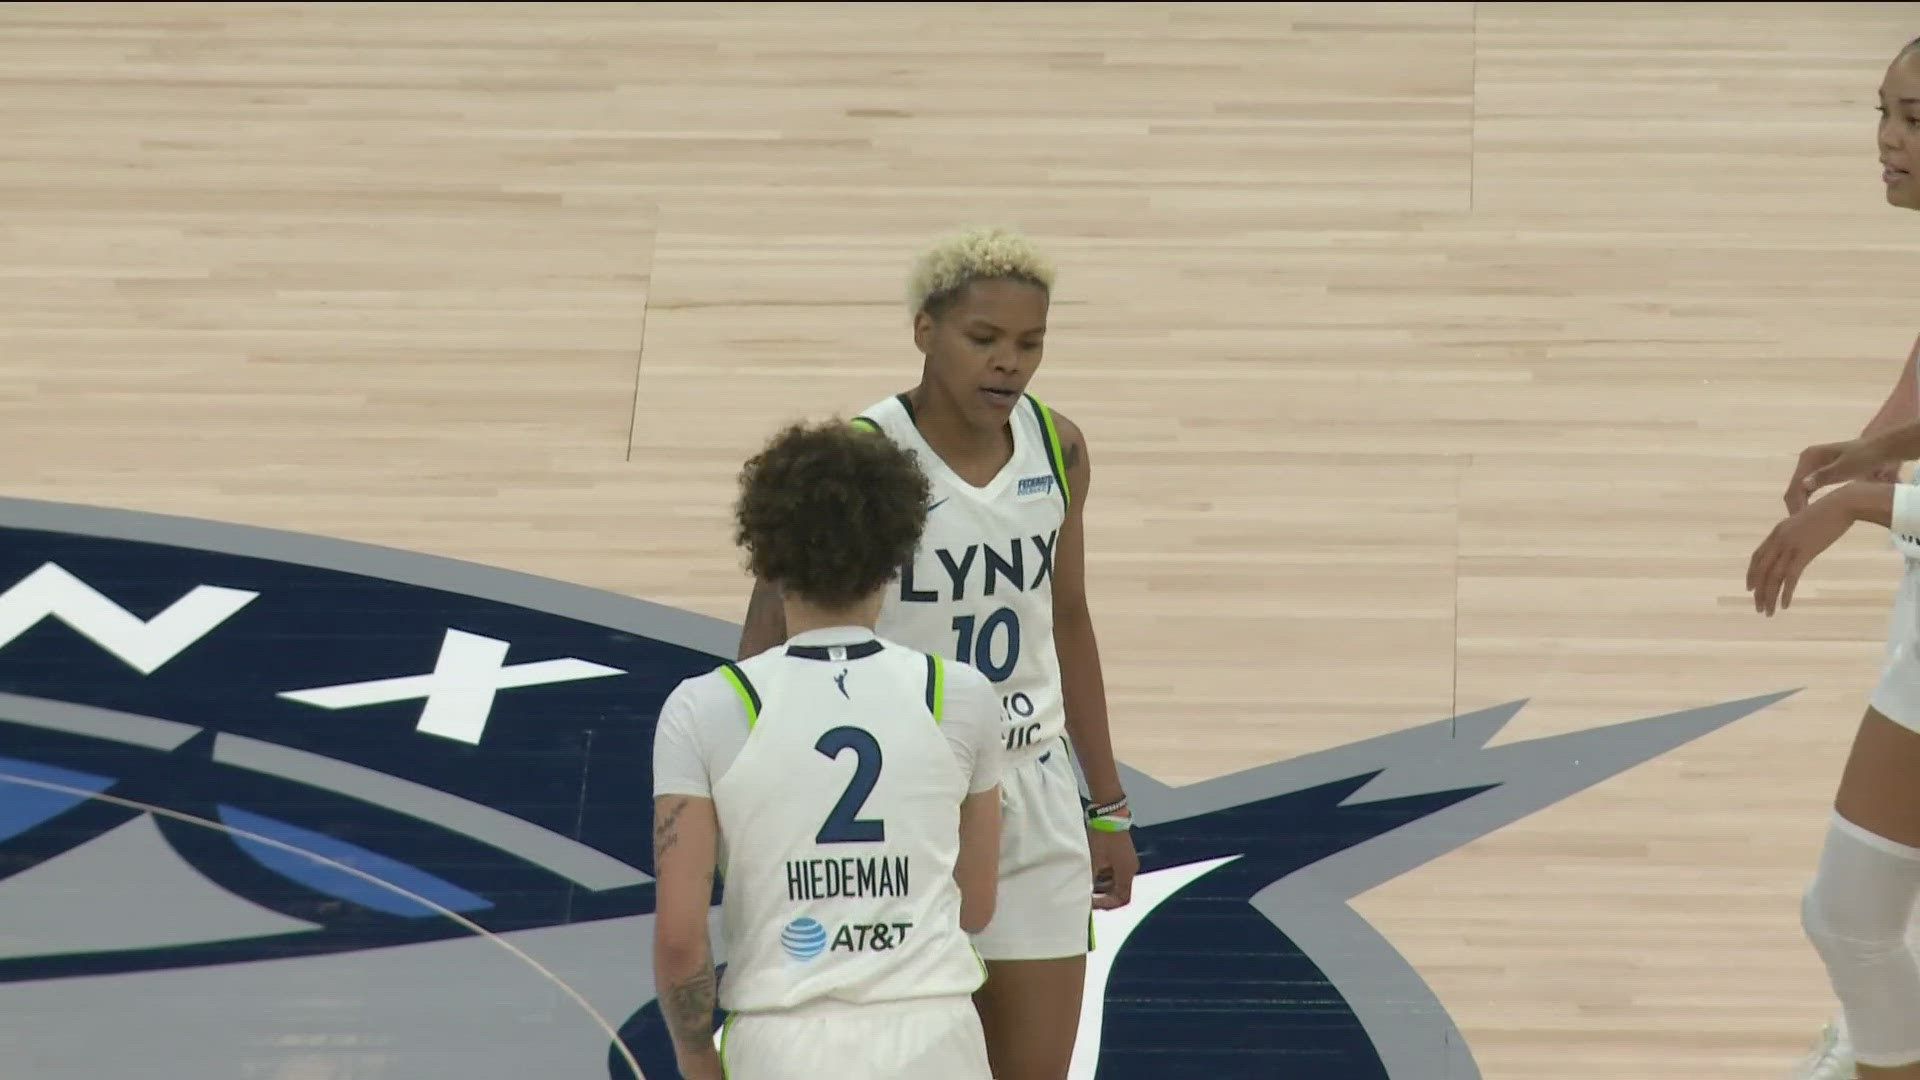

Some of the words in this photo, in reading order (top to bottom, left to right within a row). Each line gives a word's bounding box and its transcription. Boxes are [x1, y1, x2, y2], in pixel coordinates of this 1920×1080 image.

[901, 530, 1056, 602] LYNX
[952, 607, 1020, 683] 10
[815, 726, 885, 844] 2
[786, 857, 908, 900] HIEDEMAN
[831, 923, 913, 952] AT&T
